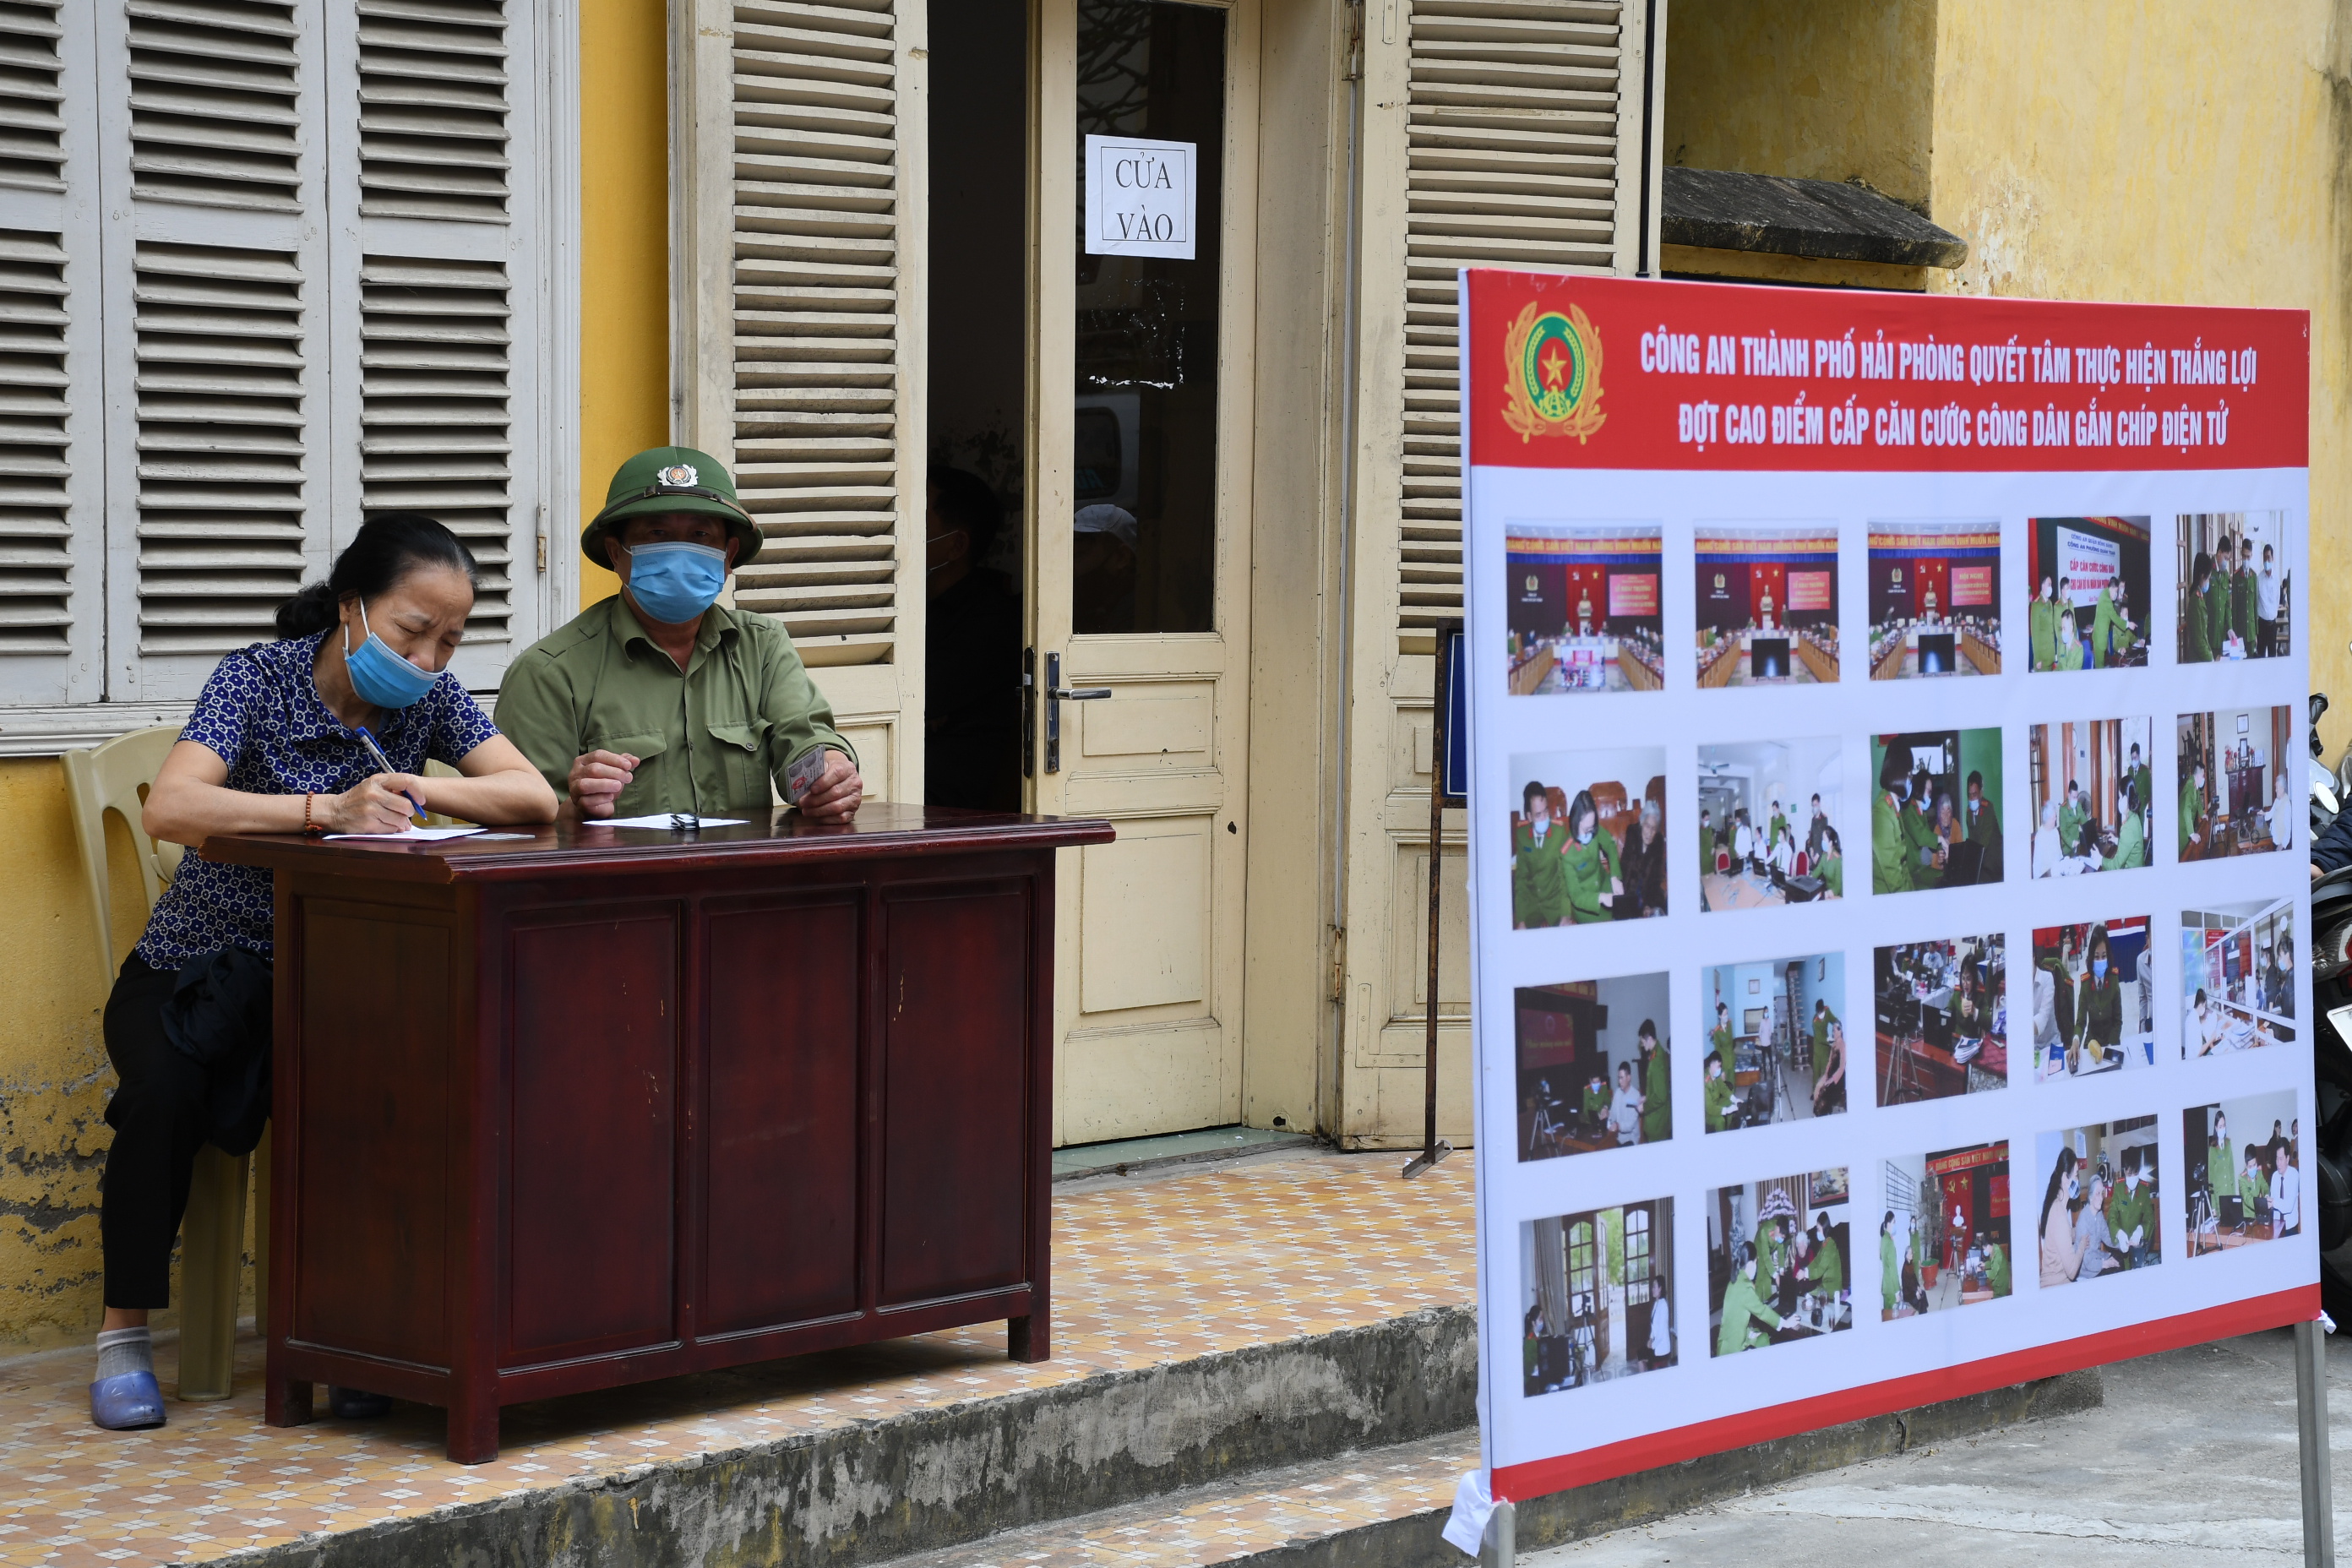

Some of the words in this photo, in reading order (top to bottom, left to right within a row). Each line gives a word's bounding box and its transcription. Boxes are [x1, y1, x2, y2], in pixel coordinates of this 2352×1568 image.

[1115, 151, 1173, 189] CỬA
[1115, 204, 1173, 241] VÀO
[1641, 324, 1700, 373] CÔNG
[1706, 335, 1736, 374] AN
[1741, 329, 1810, 377] THÀNH
[1816, 328, 1856, 378] PHỐ
[1861, 329, 1894, 379] HẢI
[1899, 335, 1964, 381] PHÒNG
[1970, 335, 2028, 386] QUYẾT
[2032, 340, 2071, 384] TÂM
[2076, 345, 2121, 392] THỰC
[2126, 342, 2166, 392] HIỆN
[2171, 337, 2227, 385] THẮNG
[2231, 346, 2257, 392] LỢI
[1679, 400, 1720, 452] ĐỢT
[1725, 404, 1767, 444] CAO
[1772, 391, 1824, 444] ĐIỂM
[1830, 395, 1870, 445] CẤP
[1876, 400, 1915, 445] CĂN
[1921, 401, 1972, 446] CƯỚC
[1977, 402, 2028, 446] CÔNG
[2033, 403, 2070, 446] DÂN
[2076, 397, 2112, 446] GẮN
[2117, 404, 2158, 446] CHÍP
[2162, 404, 2202, 453] ĐIỆN
[2207, 399, 2230, 445] TỬ
